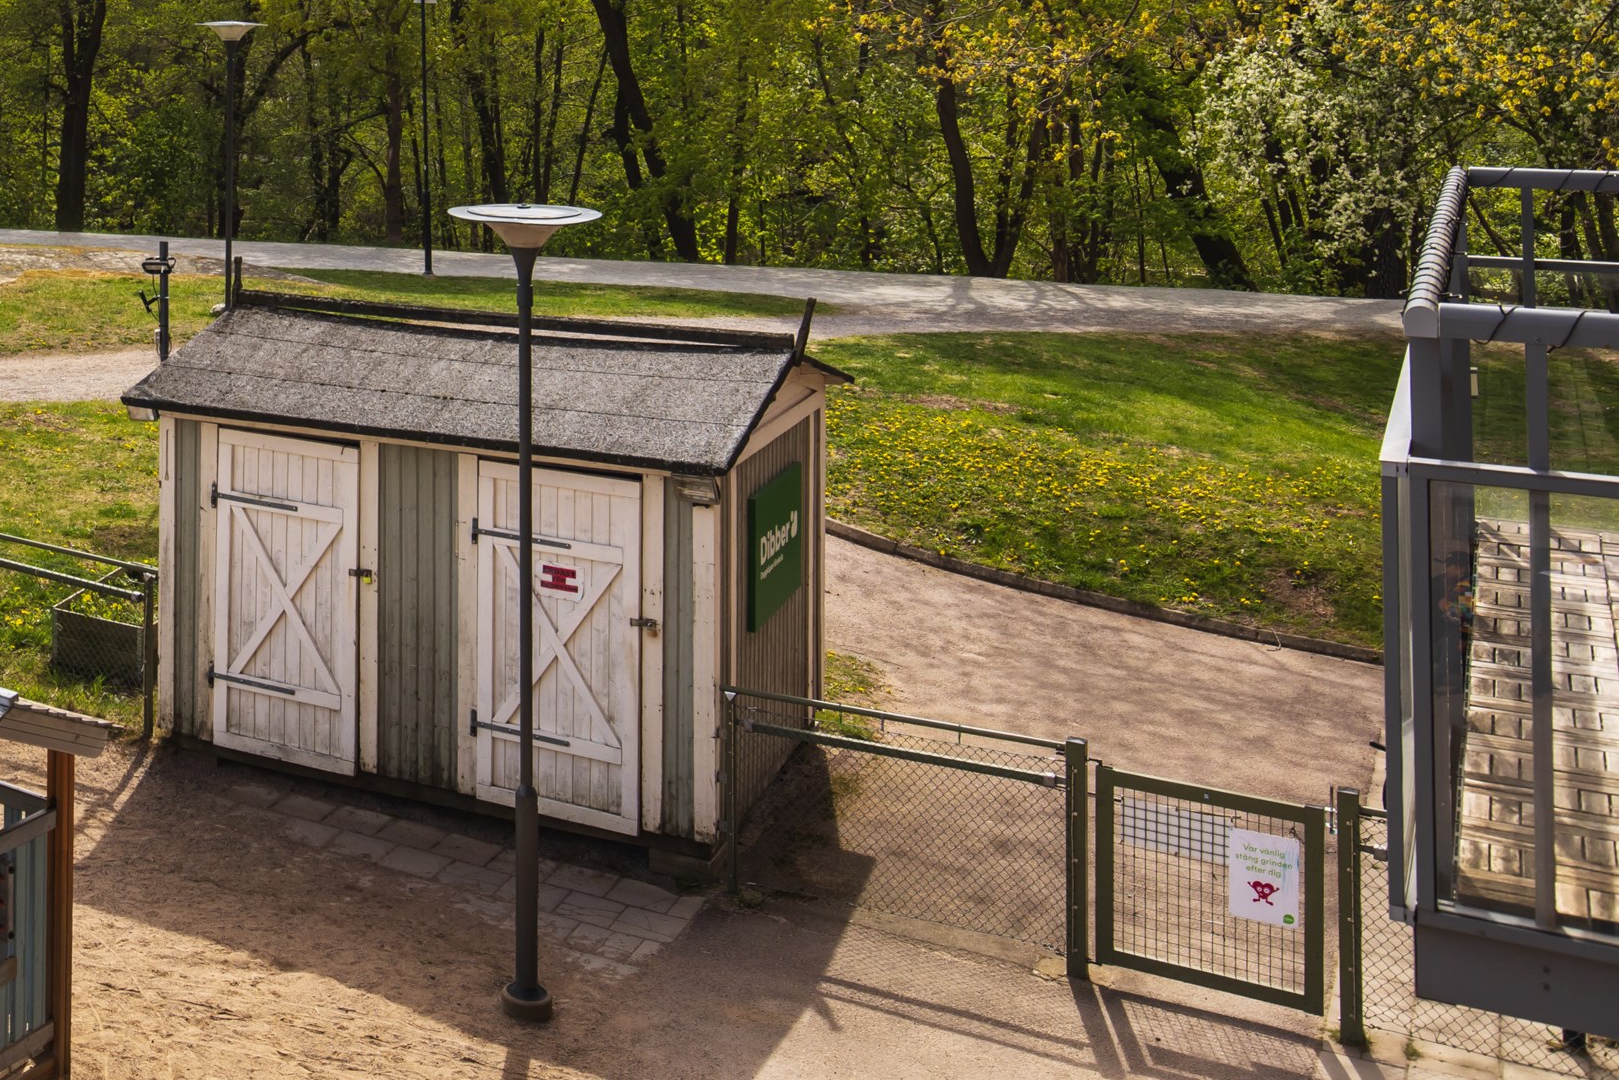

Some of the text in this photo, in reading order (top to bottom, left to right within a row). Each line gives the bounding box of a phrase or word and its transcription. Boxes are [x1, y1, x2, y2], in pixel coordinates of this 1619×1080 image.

[761, 521, 790, 566] Dibber
[1243, 843, 1257, 852] Var
[1261, 859, 1292, 869] grinden
[1246, 865, 1281, 878] efter dig
